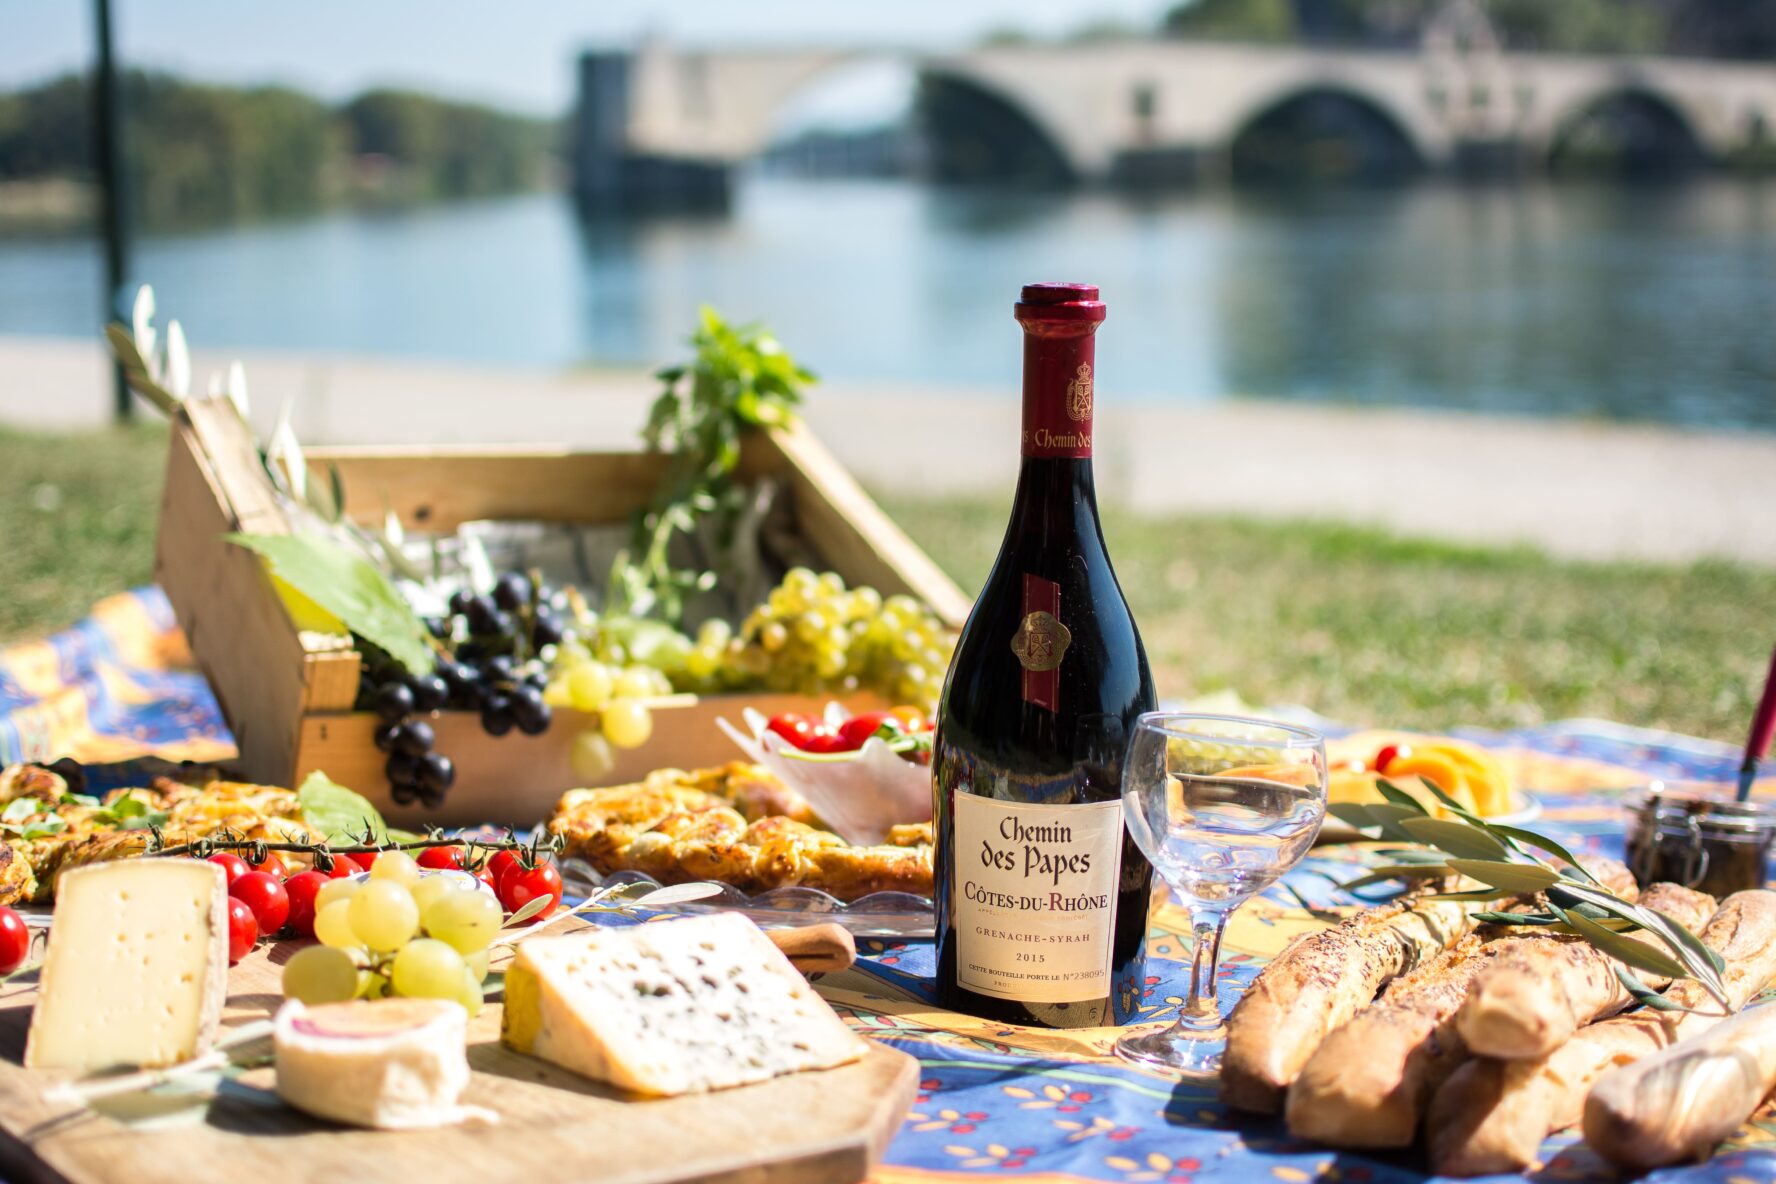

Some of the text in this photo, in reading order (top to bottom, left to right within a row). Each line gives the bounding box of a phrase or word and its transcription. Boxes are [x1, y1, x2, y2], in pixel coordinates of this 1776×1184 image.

[1034, 428, 1076, 449] Chemin
[1077, 431, 1091, 448] des
[999, 816, 1072, 844] Chemin
[980, 839, 1091, 886] des Papes
[964, 880, 1108, 912] CÔTES-DU-RHÔNE
[975, 926, 1090, 943] GRENACHE-SYRAH
[1016, 952, 1045, 963] 2015
[968, 963, 987, 974] CETTE
[988, 968, 1025, 980] BOUTEILLE
[1026, 973, 1050, 981] PORTE
